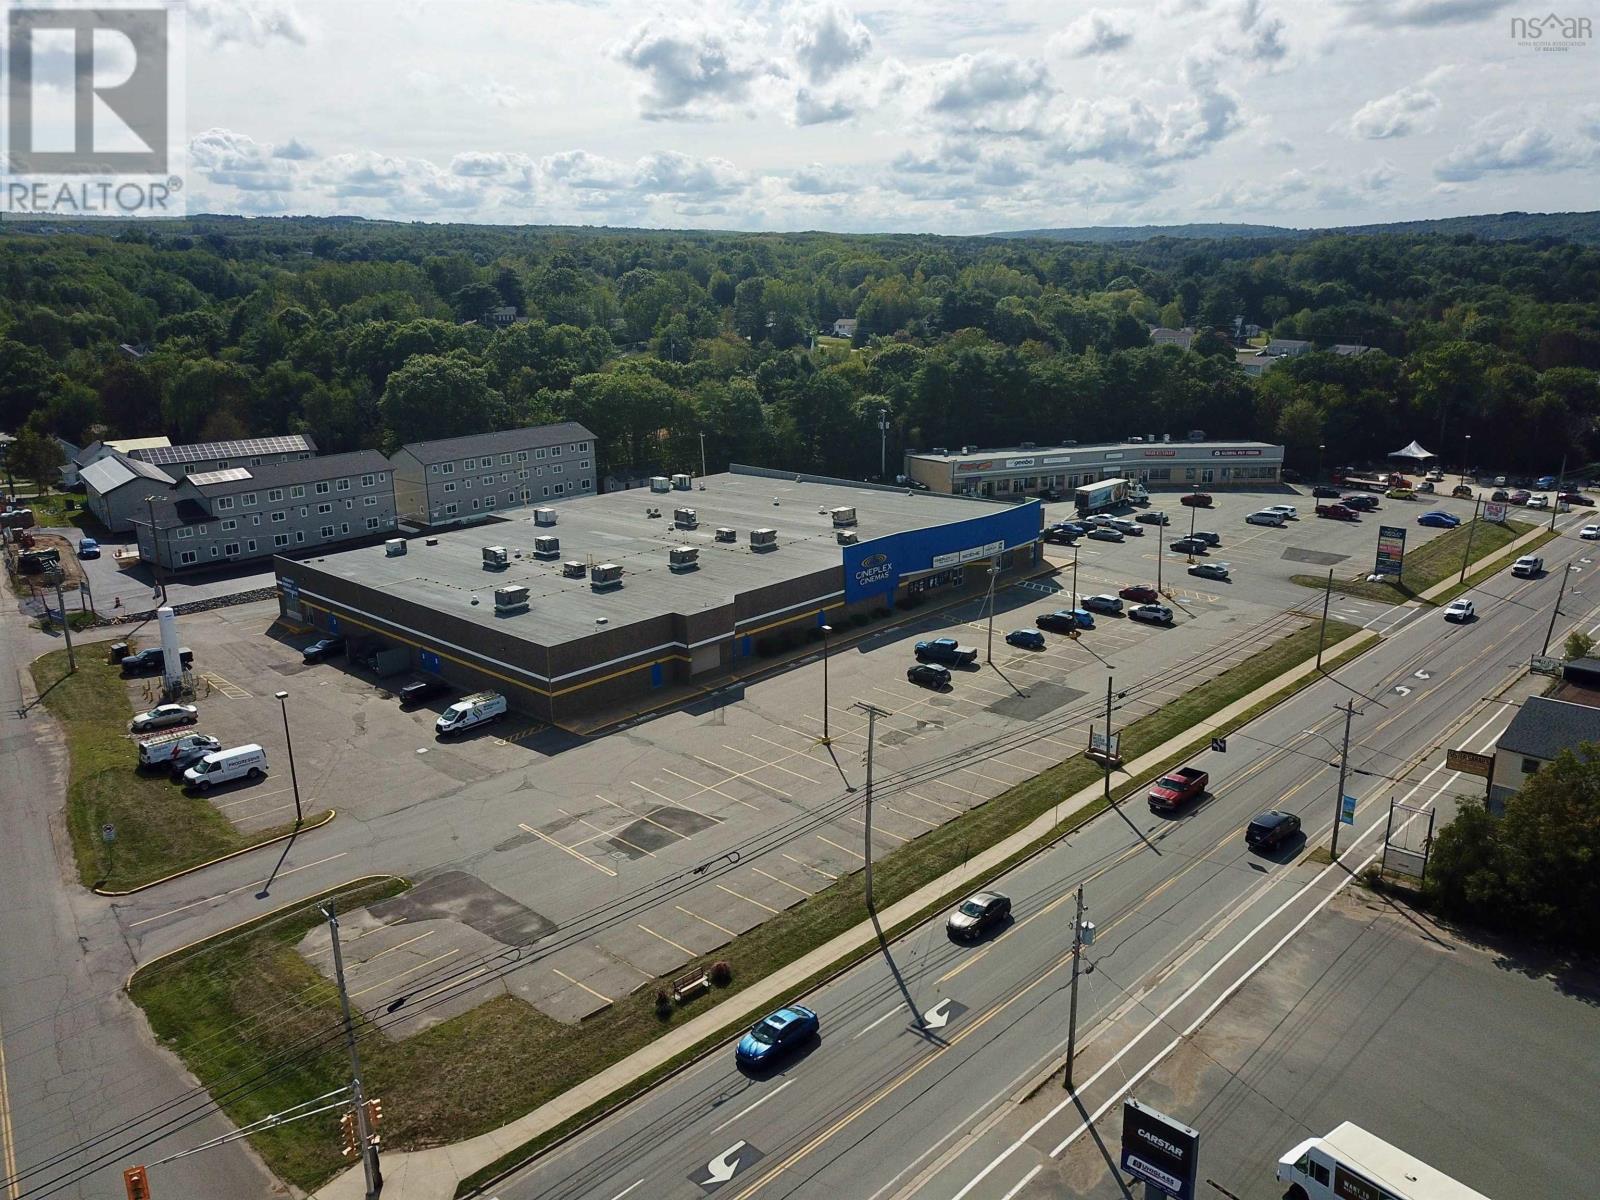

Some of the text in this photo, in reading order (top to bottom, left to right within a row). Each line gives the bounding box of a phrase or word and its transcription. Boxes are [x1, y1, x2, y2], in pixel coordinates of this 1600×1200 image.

[855, 562, 893, 580] CINEPLEX
[859, 571, 889, 586] CINEMAS
[1137, 1128, 1184, 1158] CARSTAR
